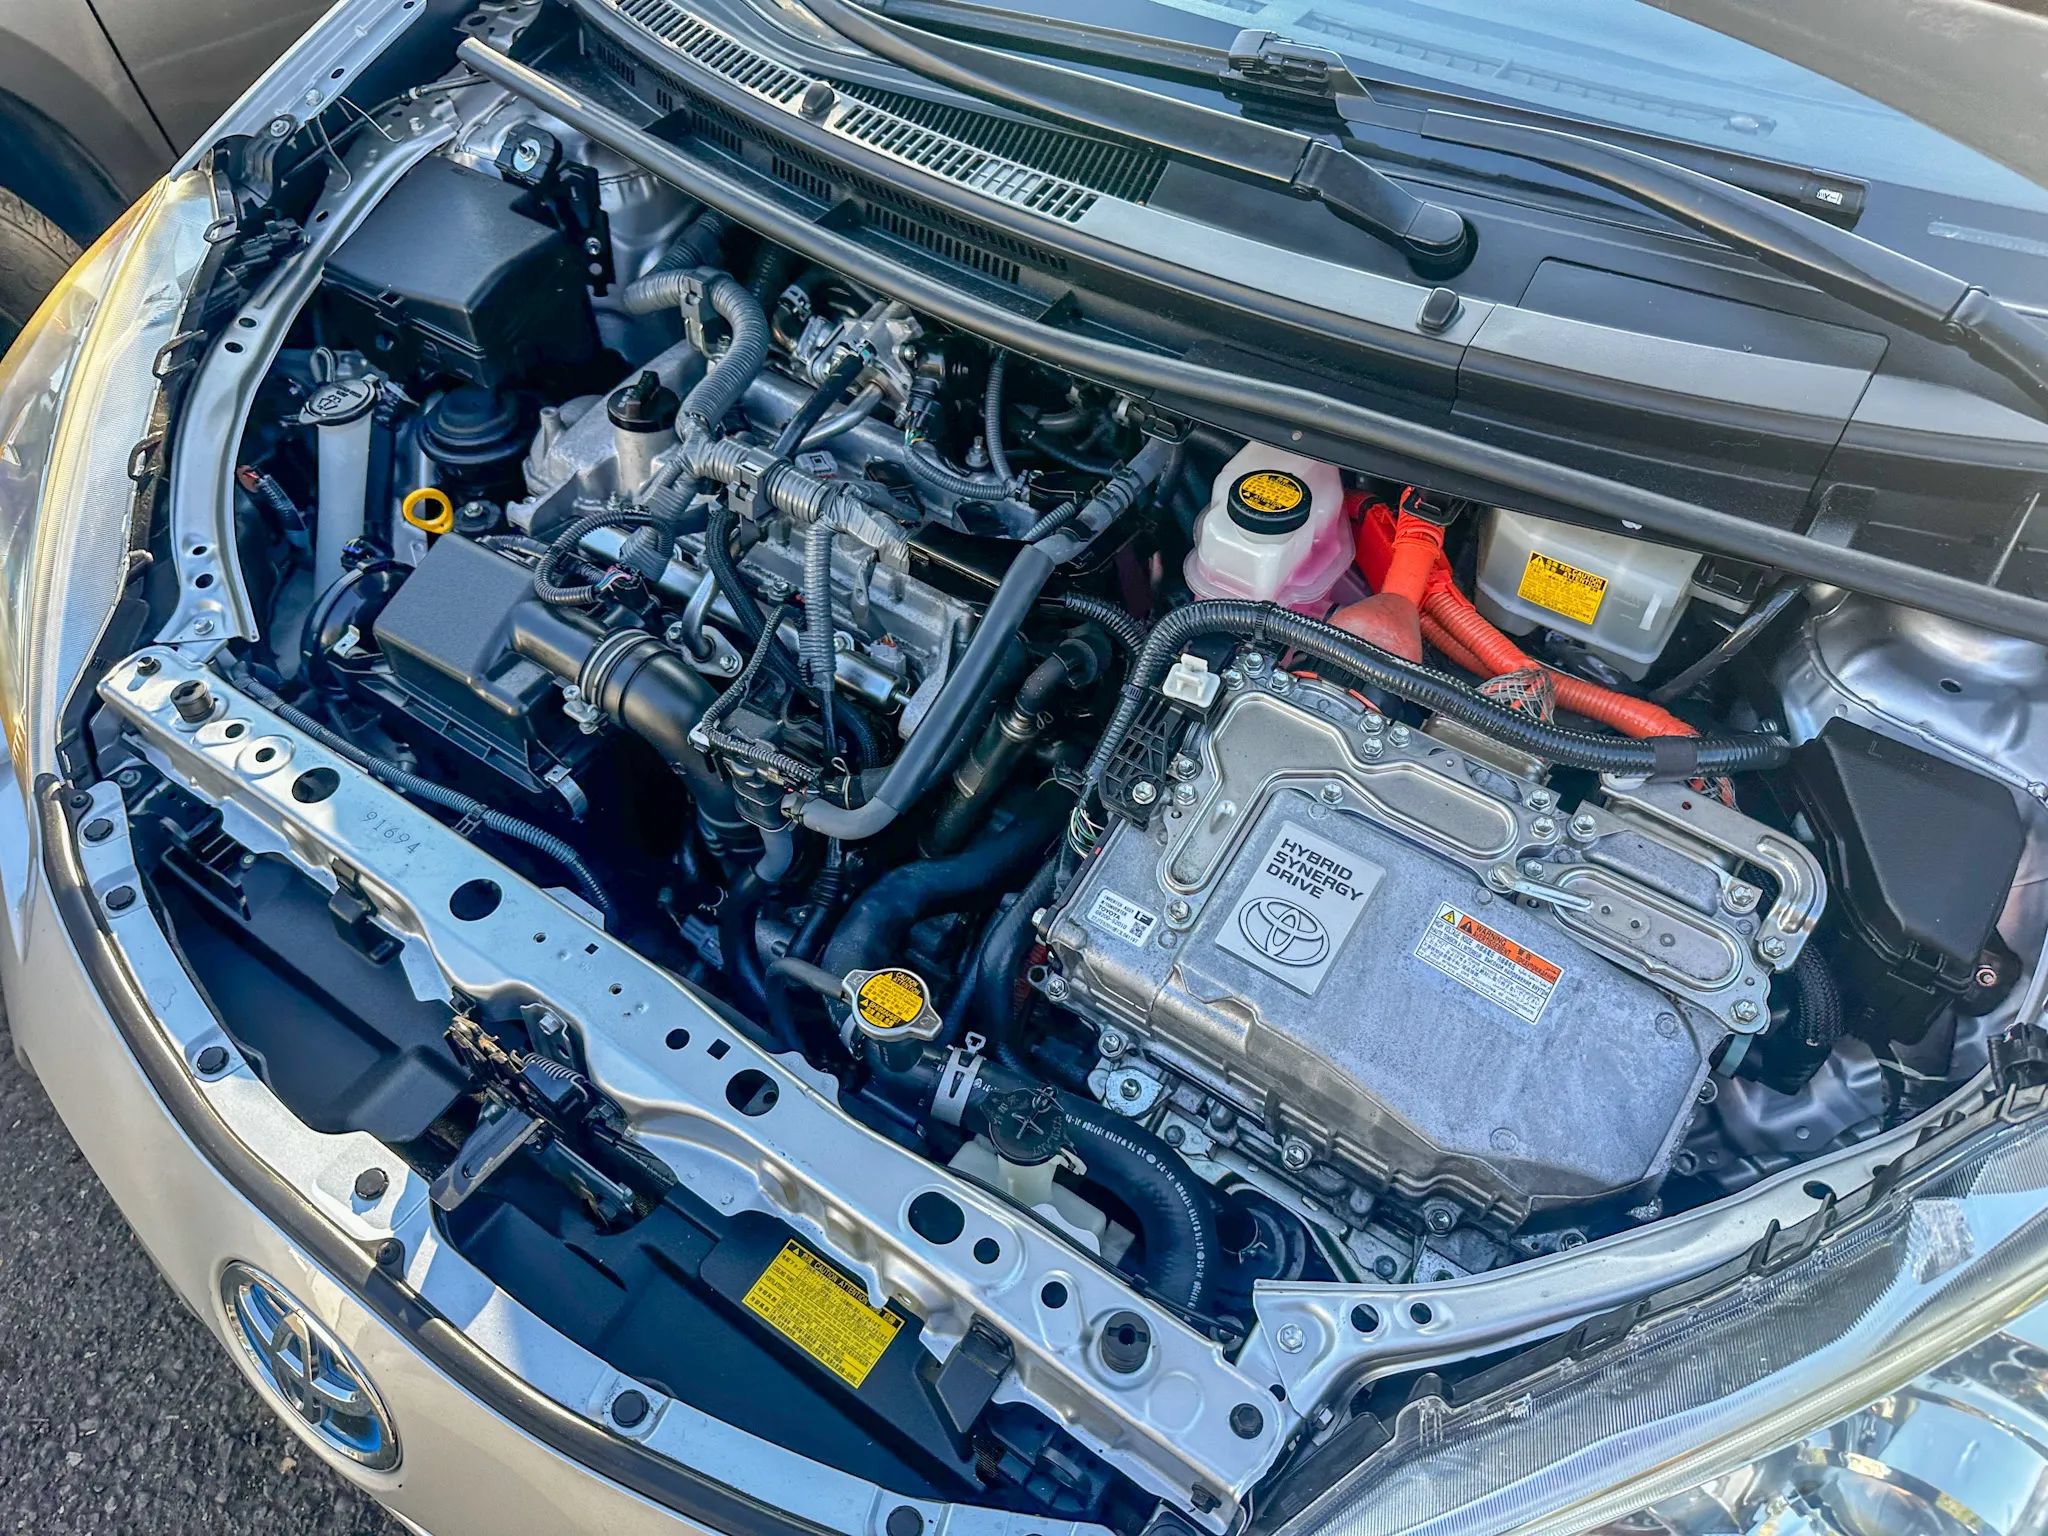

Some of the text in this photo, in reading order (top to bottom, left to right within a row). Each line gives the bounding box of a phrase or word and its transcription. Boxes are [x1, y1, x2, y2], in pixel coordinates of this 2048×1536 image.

[1562, 571, 1599, 589] ATTENTION
[1571, 568, 1601, 584] CAUTION
[361, 811, 421, 853] 91694
[1280, 836, 1353, 882] HYBRID
[1266, 861, 1324, 899] DRIVE
[1273, 848, 1364, 904] SYNERGY
[1097, 904, 1121, 919] TOYOTA
[1471, 929, 1511, 956] AVERTISSEMENT
[1475, 923, 1507, 946] WARNING
[891, 975, 920, 995] ATTENTION
[895, 971, 919, 987] CAUTION
[813, 1262, 868, 1305] CAUTION ATTENTION
